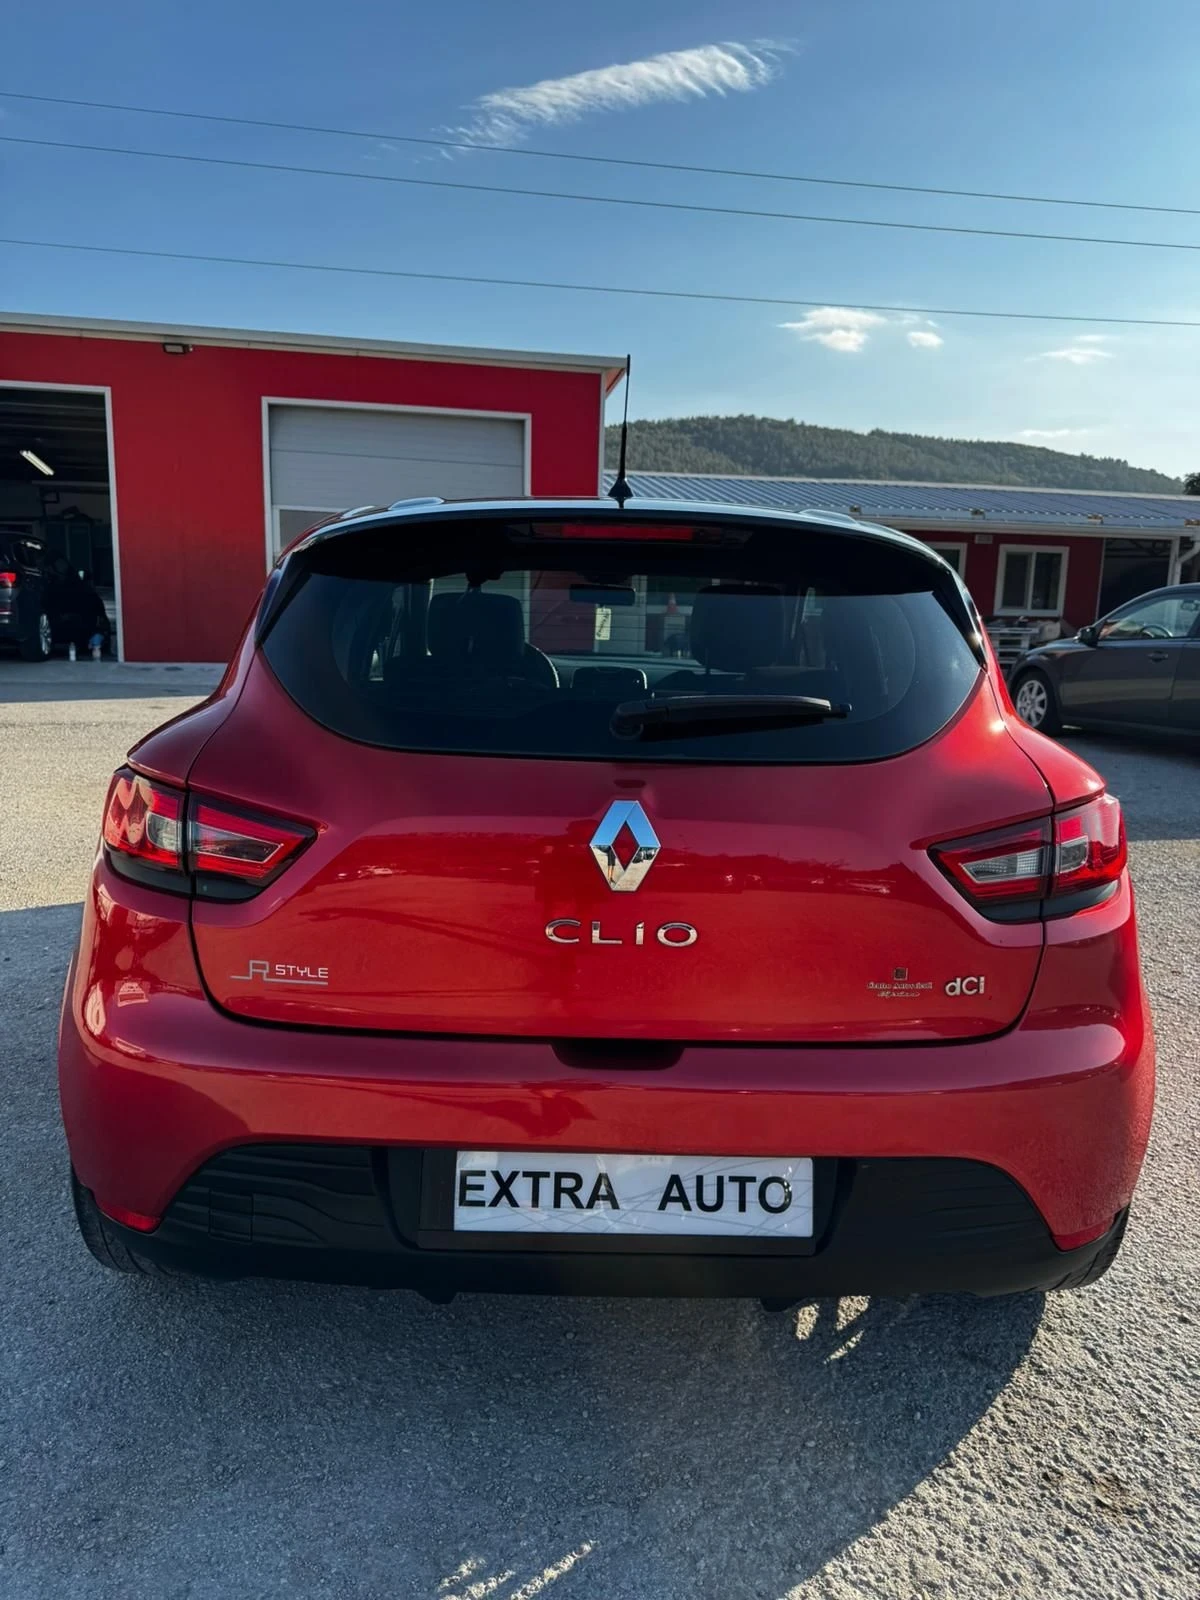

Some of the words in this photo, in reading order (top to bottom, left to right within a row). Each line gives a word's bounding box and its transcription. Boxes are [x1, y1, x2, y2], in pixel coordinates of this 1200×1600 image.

[275, 964, 329, 979] STYLE
[458, 1169, 620, 1210] EXTRA
[657, 1174, 793, 1214] AUTO
